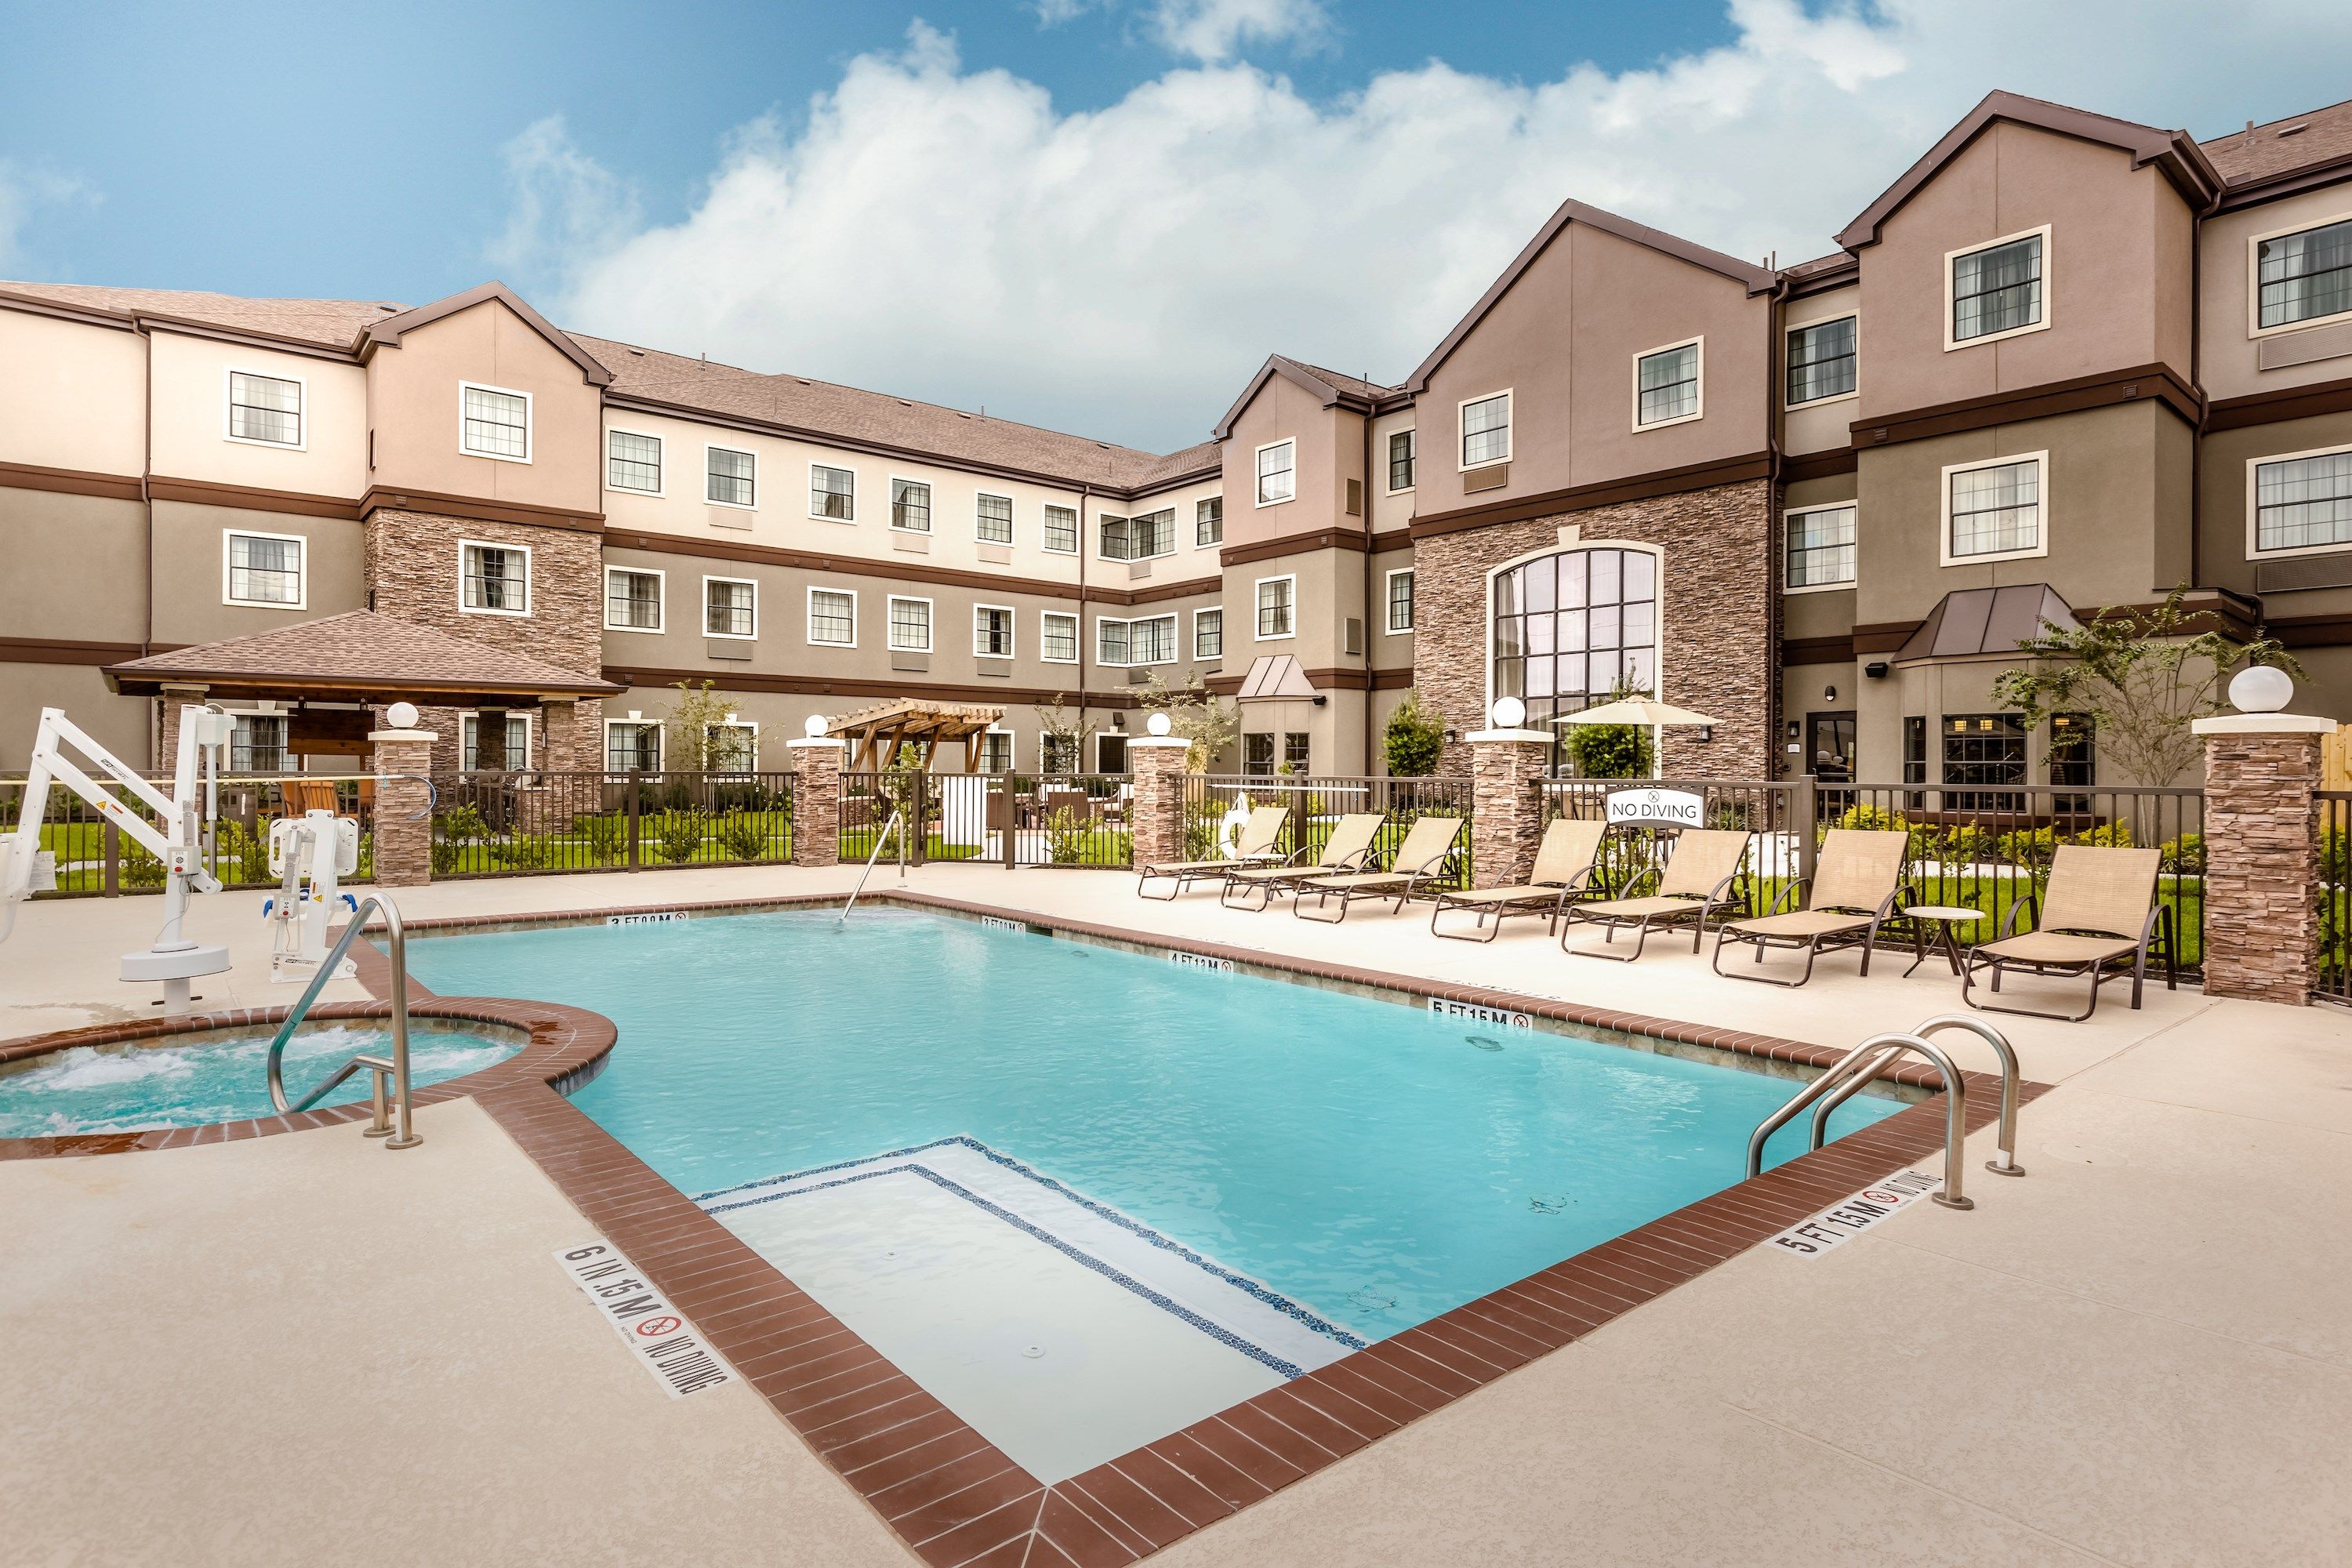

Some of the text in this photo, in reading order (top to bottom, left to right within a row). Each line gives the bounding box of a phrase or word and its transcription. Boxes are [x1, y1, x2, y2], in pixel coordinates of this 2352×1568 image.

[1613, 804, 1697, 818] NO DIVING
[1181, 955, 1192, 964] FT
[1208, 960, 1218, 969] M
[1433, 1001, 1442, 1012] 5
[1450, 1004, 1466, 1017] FT
[1492, 1011, 1507, 1025] M
[1879, 1183, 1920, 1197] NO
[1891, 1171, 1944, 1190] DIVING
[1843, 1200, 1891, 1218] M
[1795, 1222, 1845, 1244] FT
[564, 1245, 607, 1261] 6
[1775, 1237, 1818, 1253] 5
[575, 1258, 626, 1281] IN
[608, 1294, 662, 1319] M
[642, 1335, 695, 1358] NO
[656, 1350, 728, 1395] DIVING
